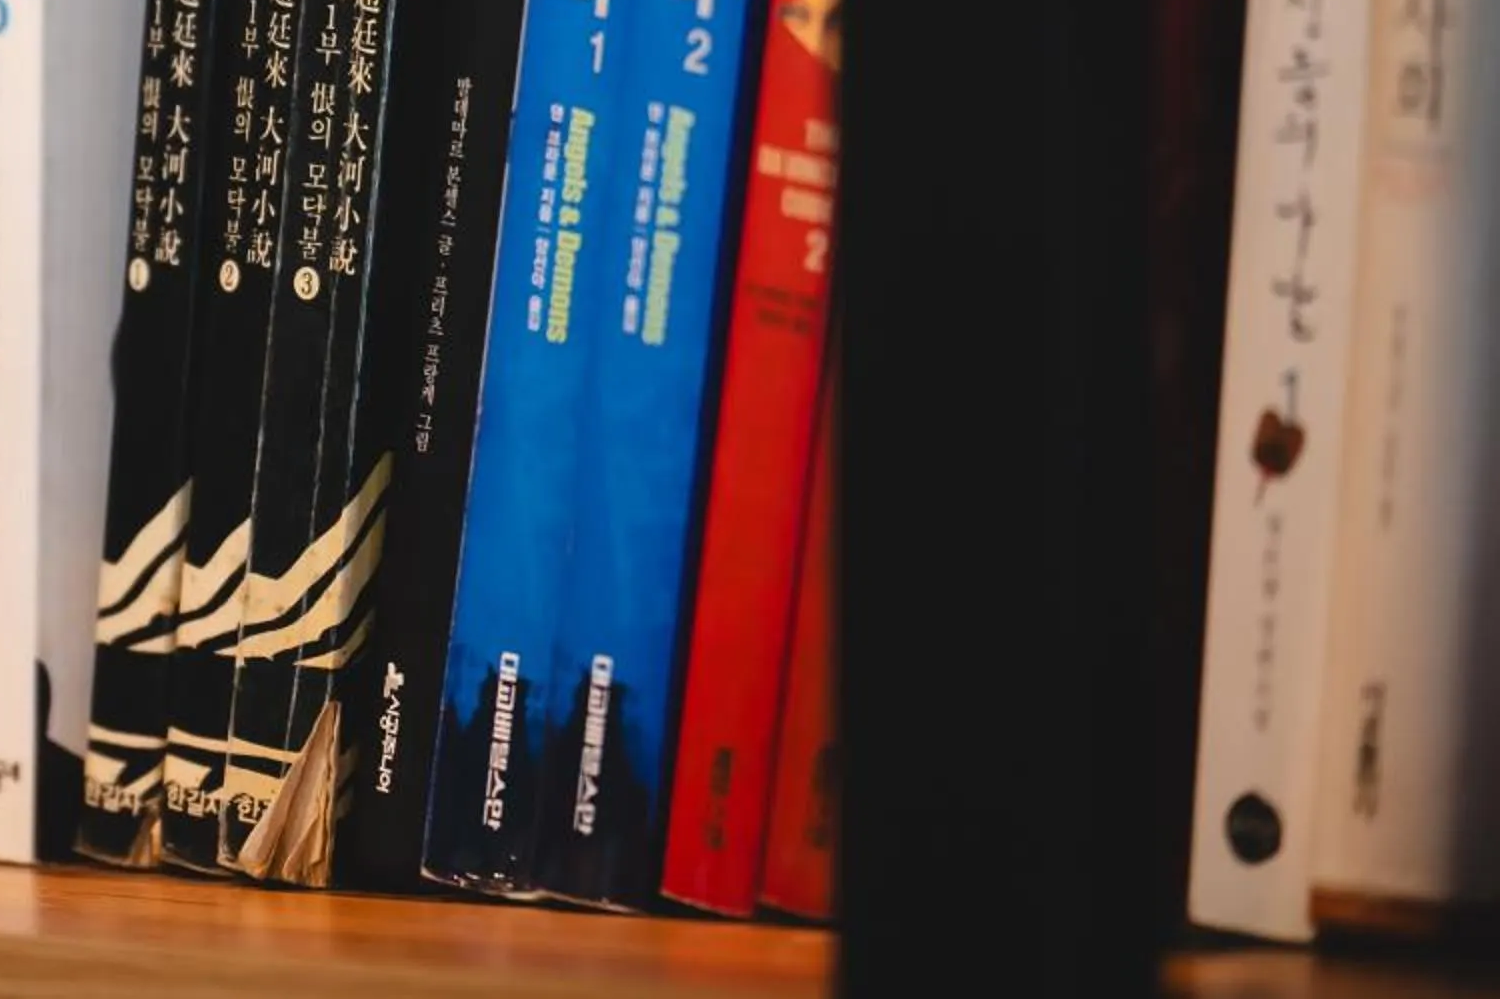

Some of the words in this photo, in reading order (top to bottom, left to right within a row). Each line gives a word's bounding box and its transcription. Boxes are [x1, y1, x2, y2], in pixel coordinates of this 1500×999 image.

[589, 30, 605, 74] 1
[682, 27, 713, 75] 2
[561, 105, 595, 204] Angels
[298, 163, 330, 262] 모닥불
[546, 229, 582, 344] Demons
[376, 694, 402, 794] 시공주니어
